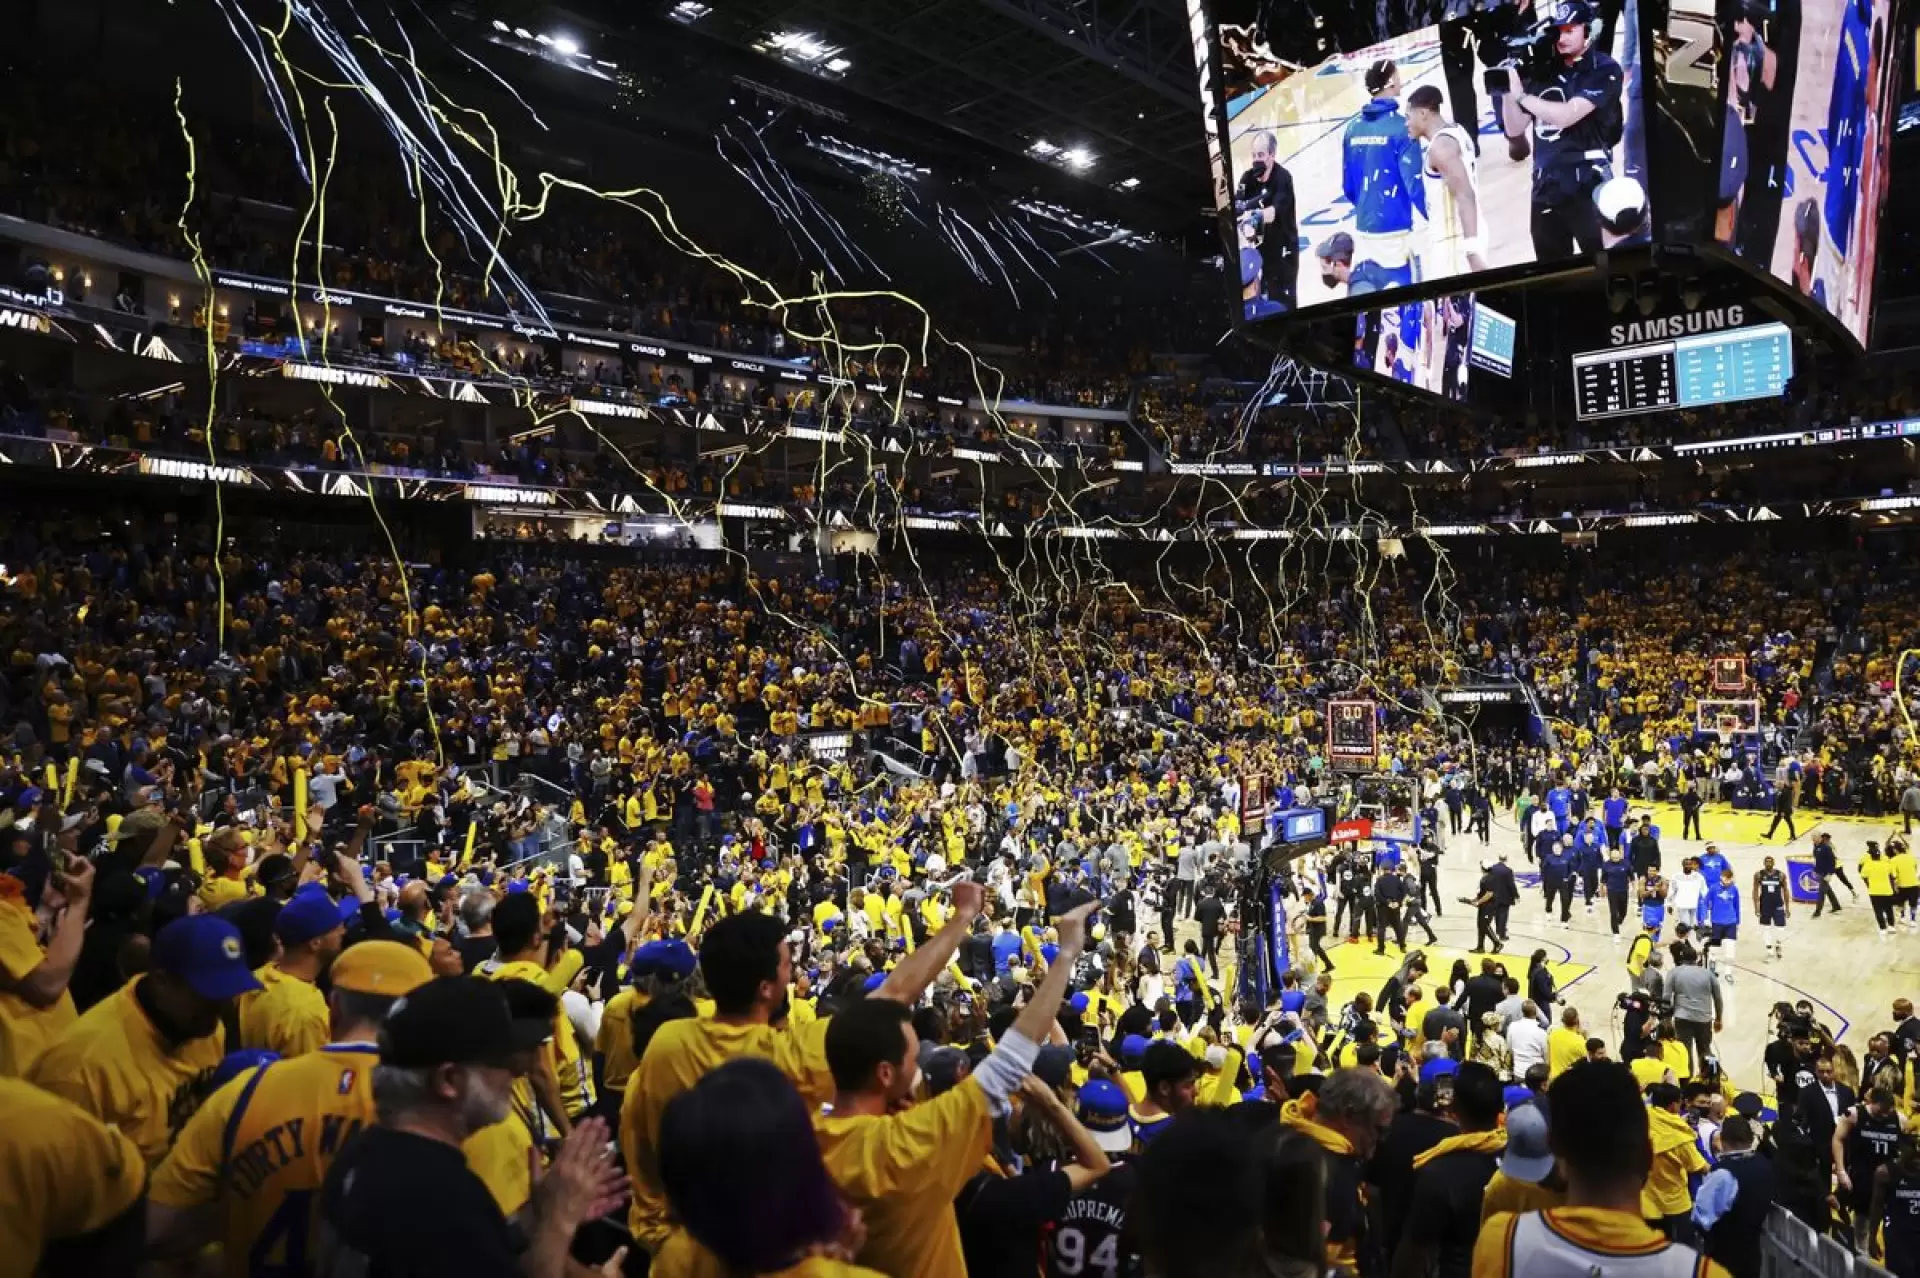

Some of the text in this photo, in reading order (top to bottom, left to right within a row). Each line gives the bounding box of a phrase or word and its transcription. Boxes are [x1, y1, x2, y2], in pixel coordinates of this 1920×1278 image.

[254, 282, 288, 295] PARTNERS
[1610, 304, 1744, 345] SAMSUNG
[631, 343, 658, 355] CHASE
[731, 361, 765, 372] ORACLE
[345, 370, 388, 388] WIN
[615, 405, 648, 420] WIN
[1554, 454, 1585, 465] WIN
[139, 457, 251, 484] WARRIORS WIN
[517, 490, 556, 505] WIN
[756, 507, 785, 519] WIN
[1668, 513, 1699, 525] WIN
[1481, 691, 1511, 702] WIN
[1871, 1140, 1889, 1155] 77
[233, 1117, 304, 1199] FORTY
[1909, 1199, 1920, 1215] 2
[1056, 1226, 1119, 1278] 94
